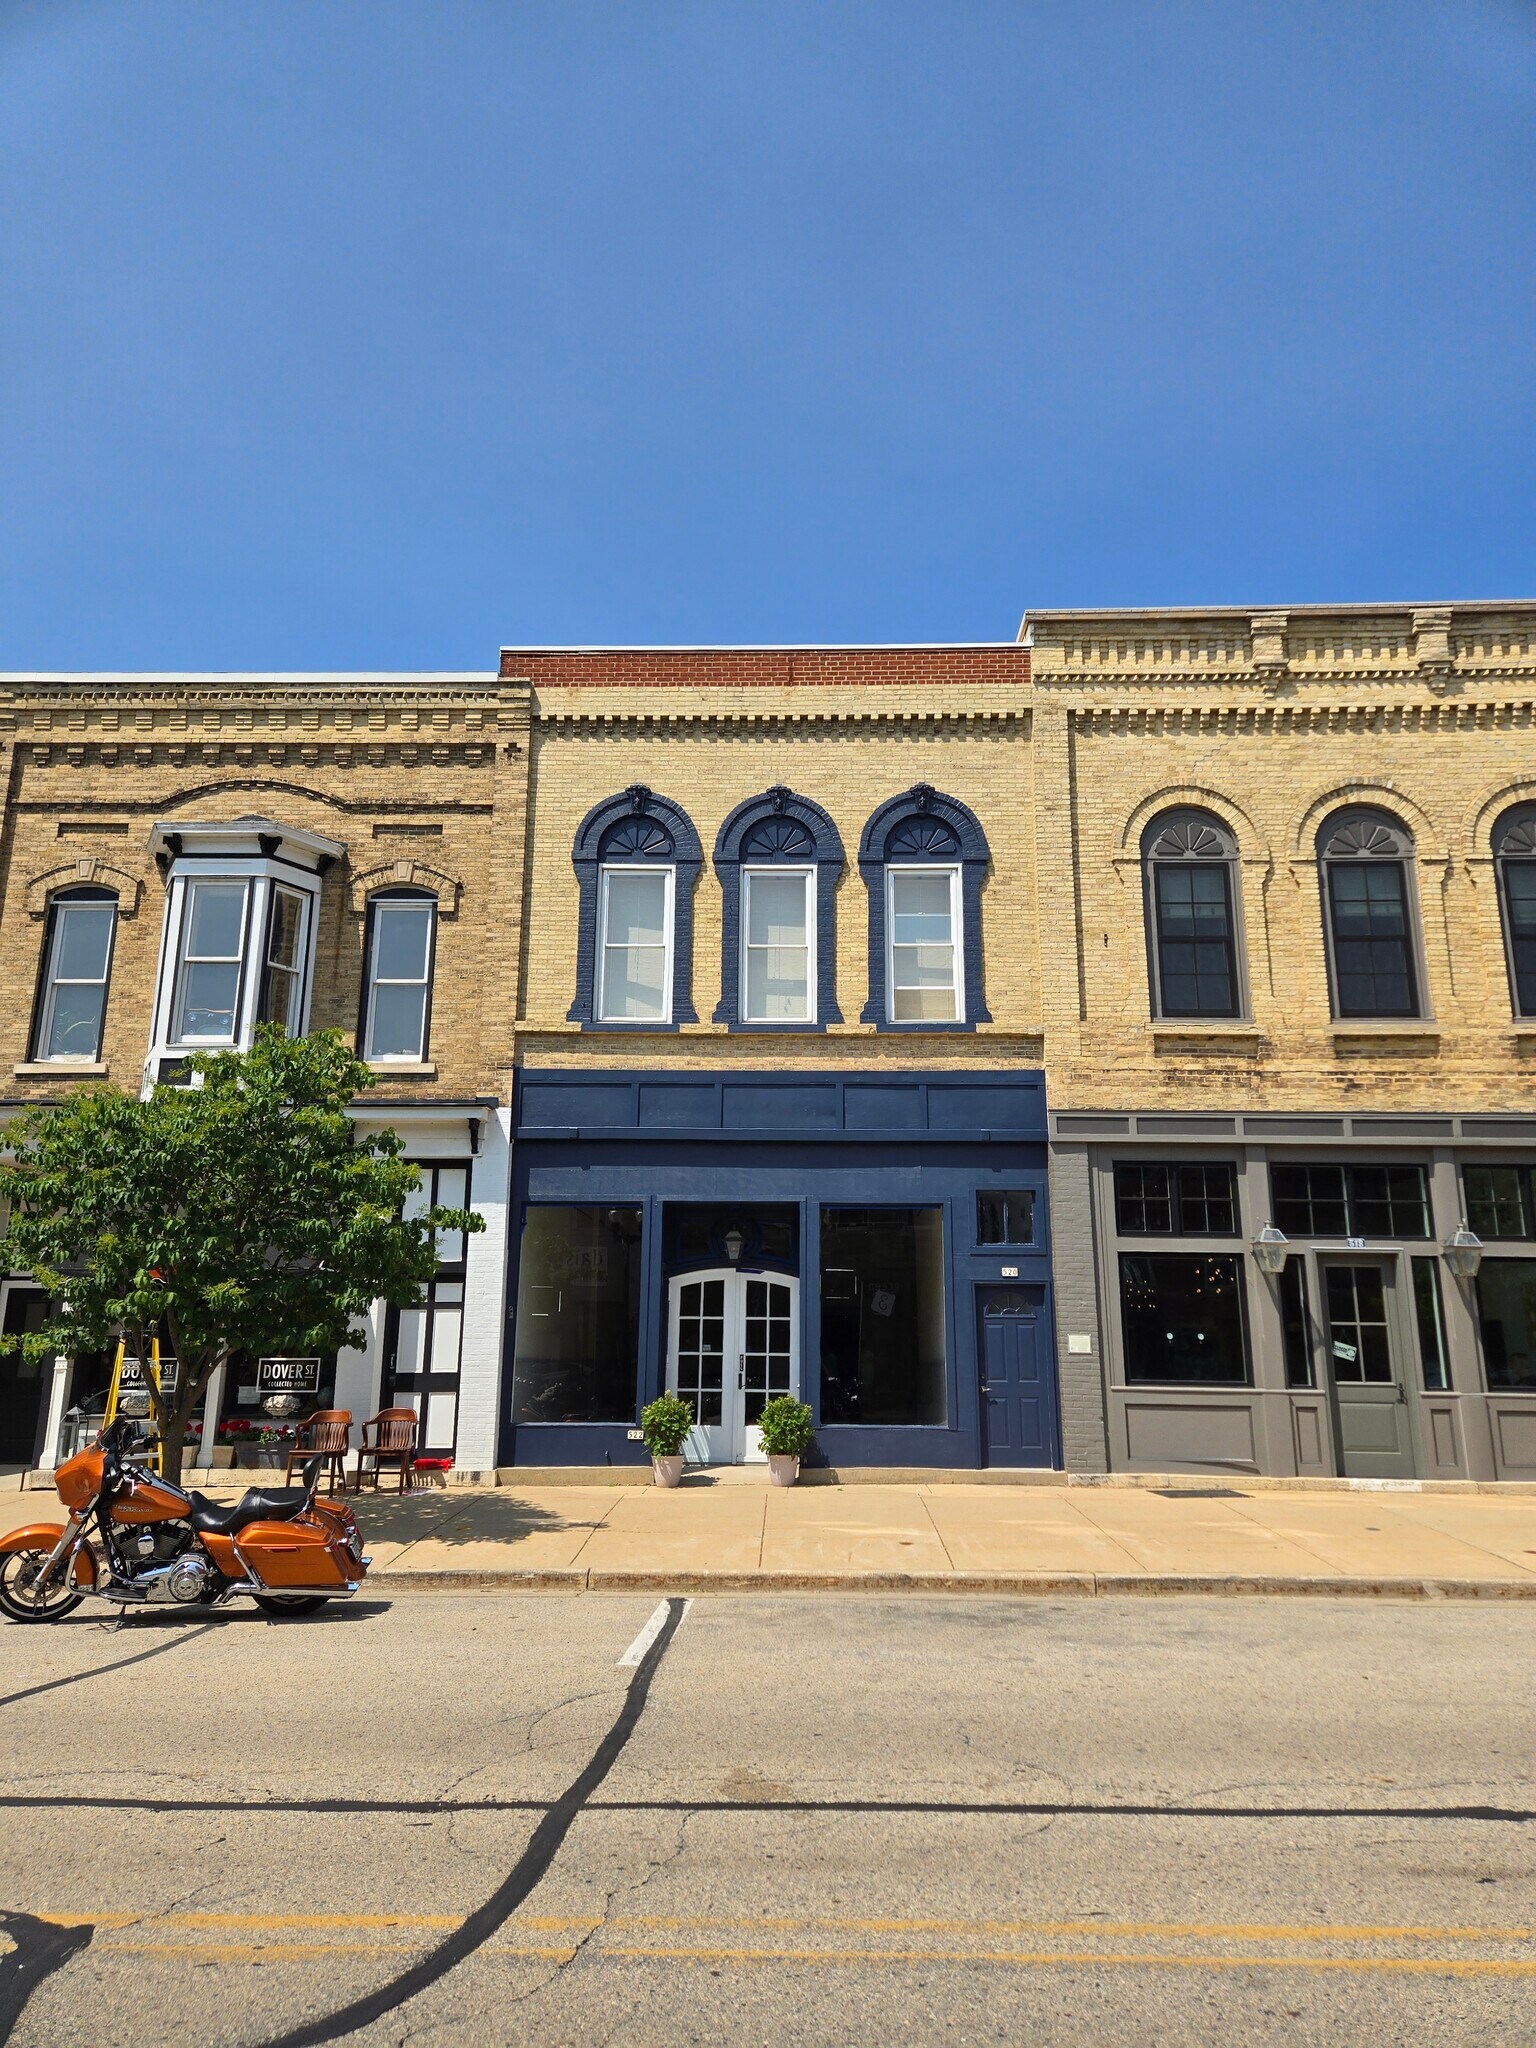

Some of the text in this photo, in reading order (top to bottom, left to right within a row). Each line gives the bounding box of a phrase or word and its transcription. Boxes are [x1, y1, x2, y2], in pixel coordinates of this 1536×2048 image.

[1003, 1268, 1017, 1276] 520
[263, 1364, 315, 1379] DOVER ST.
[628, 1431, 643, 1439] 522
